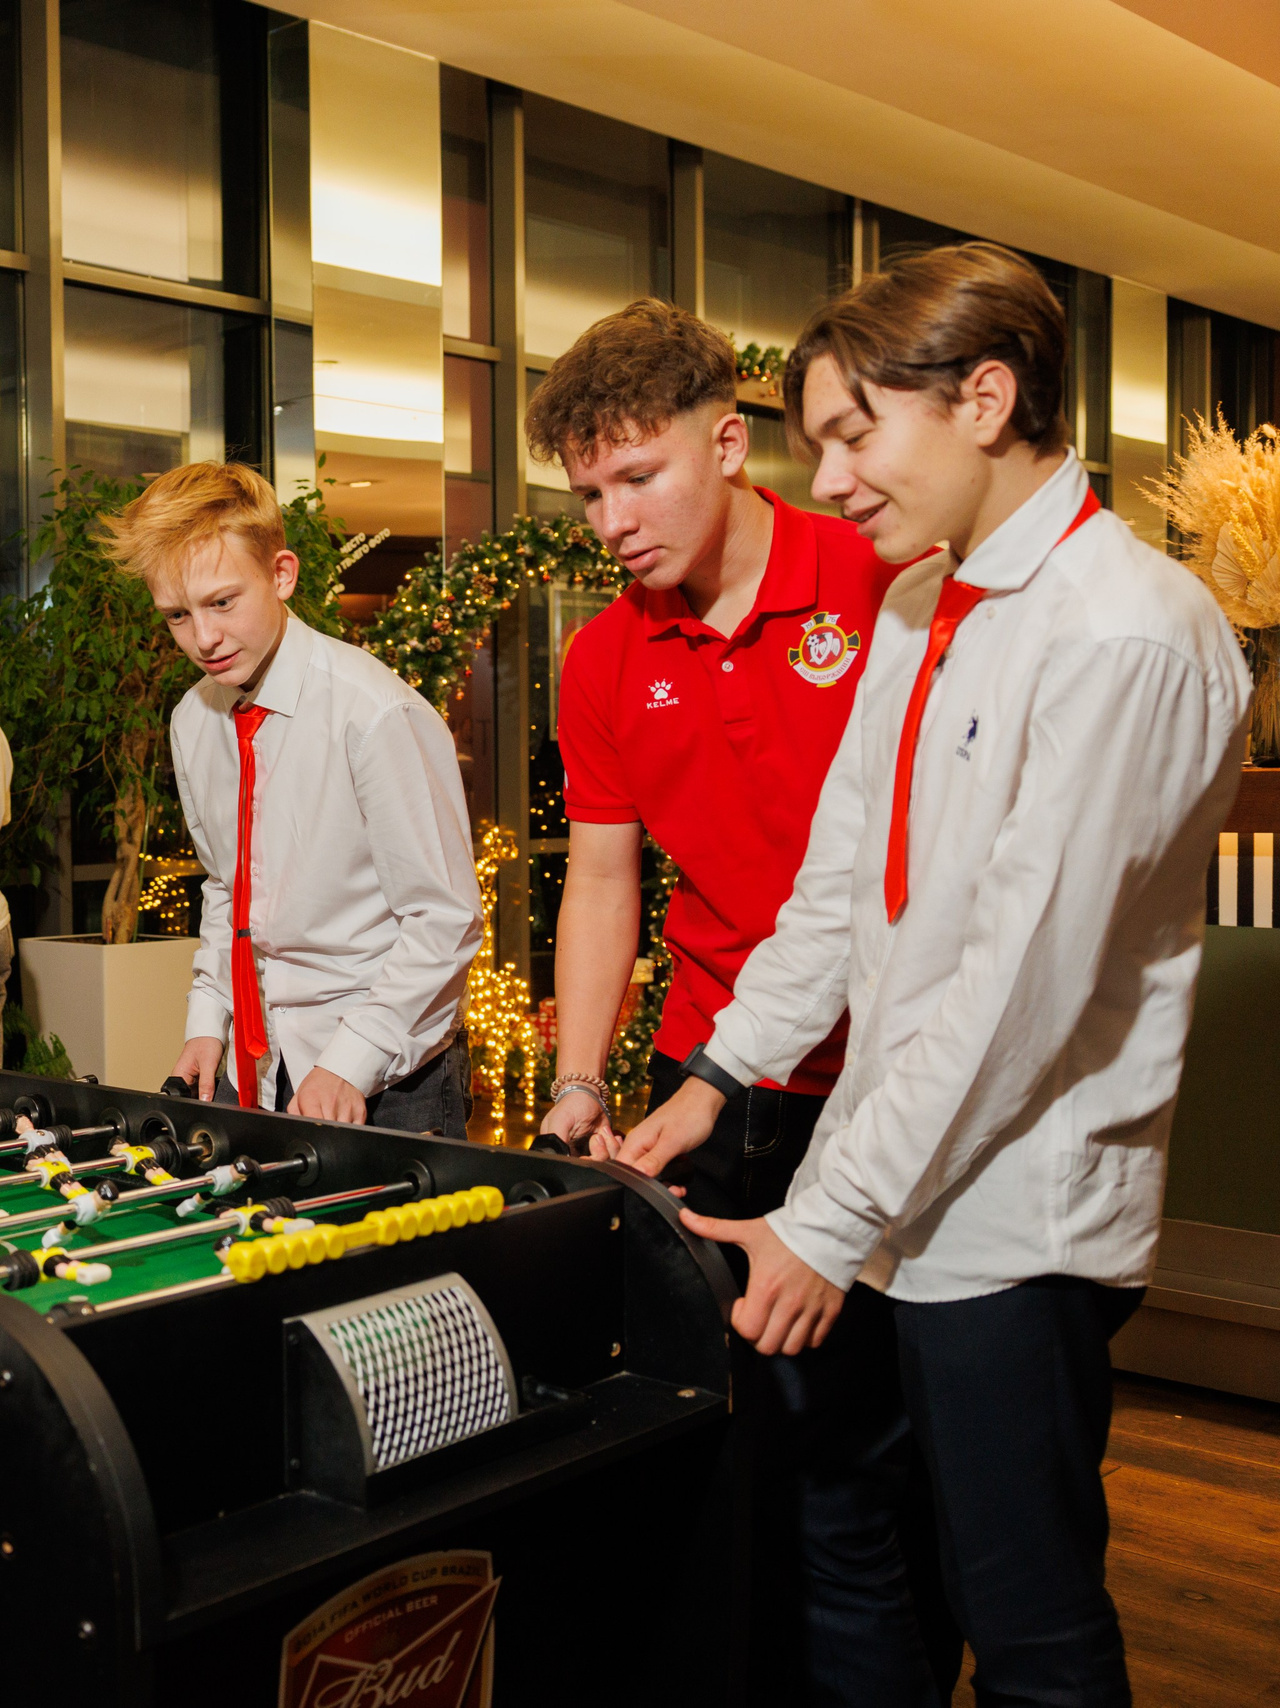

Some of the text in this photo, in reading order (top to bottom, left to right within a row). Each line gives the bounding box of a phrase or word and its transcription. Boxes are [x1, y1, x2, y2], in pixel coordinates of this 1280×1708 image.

[646, 697, 680, 710] KELME
[411, 1567, 438, 1583] CUP
[344, 1594, 439, 1644] OFFICIAL BEER
[314, 1630, 463, 1708] Bud
